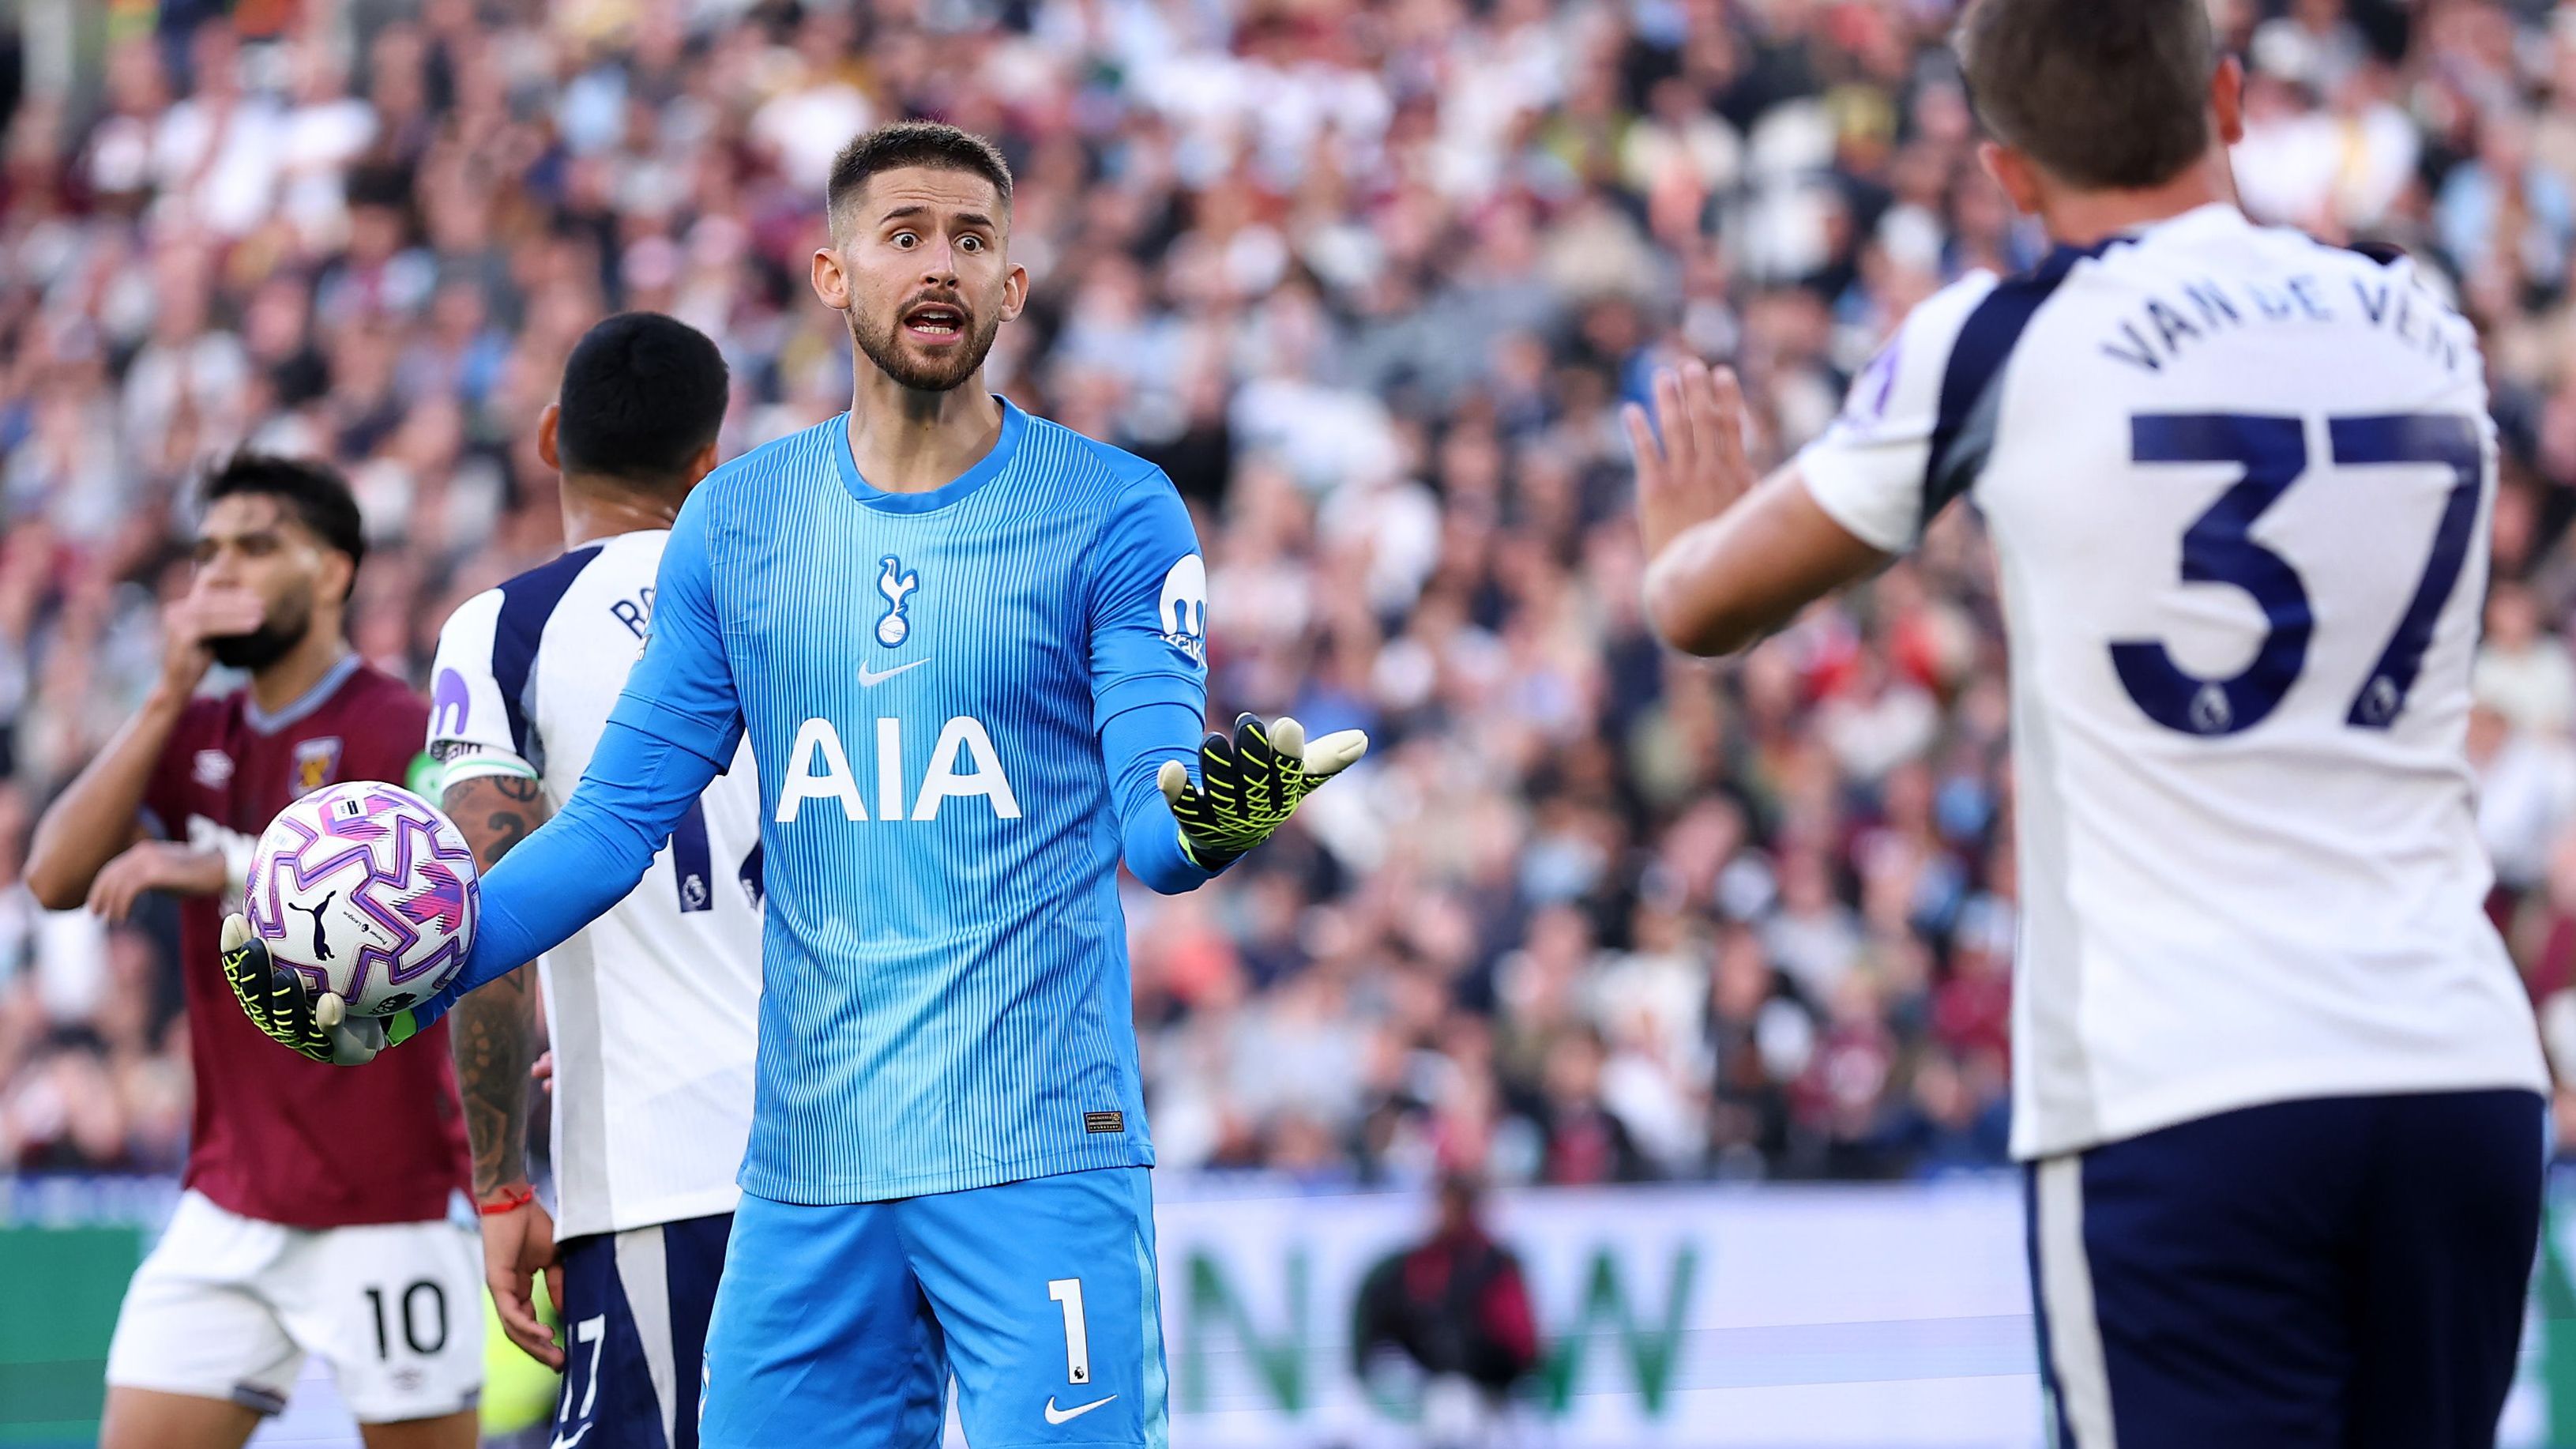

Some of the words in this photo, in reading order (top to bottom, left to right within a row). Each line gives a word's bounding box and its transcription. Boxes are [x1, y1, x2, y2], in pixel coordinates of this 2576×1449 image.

[2100, 277, 2240, 371] VAN
[2248, 276, 2332, 320] DE
[2109, 412, 2483, 736] 37
[775, 717, 1022, 822] AIA
[364, 1280, 447, 1361] 10
[558, 1312, 606, 1424] 17
[1048, 1278, 1090, 1384] 1
